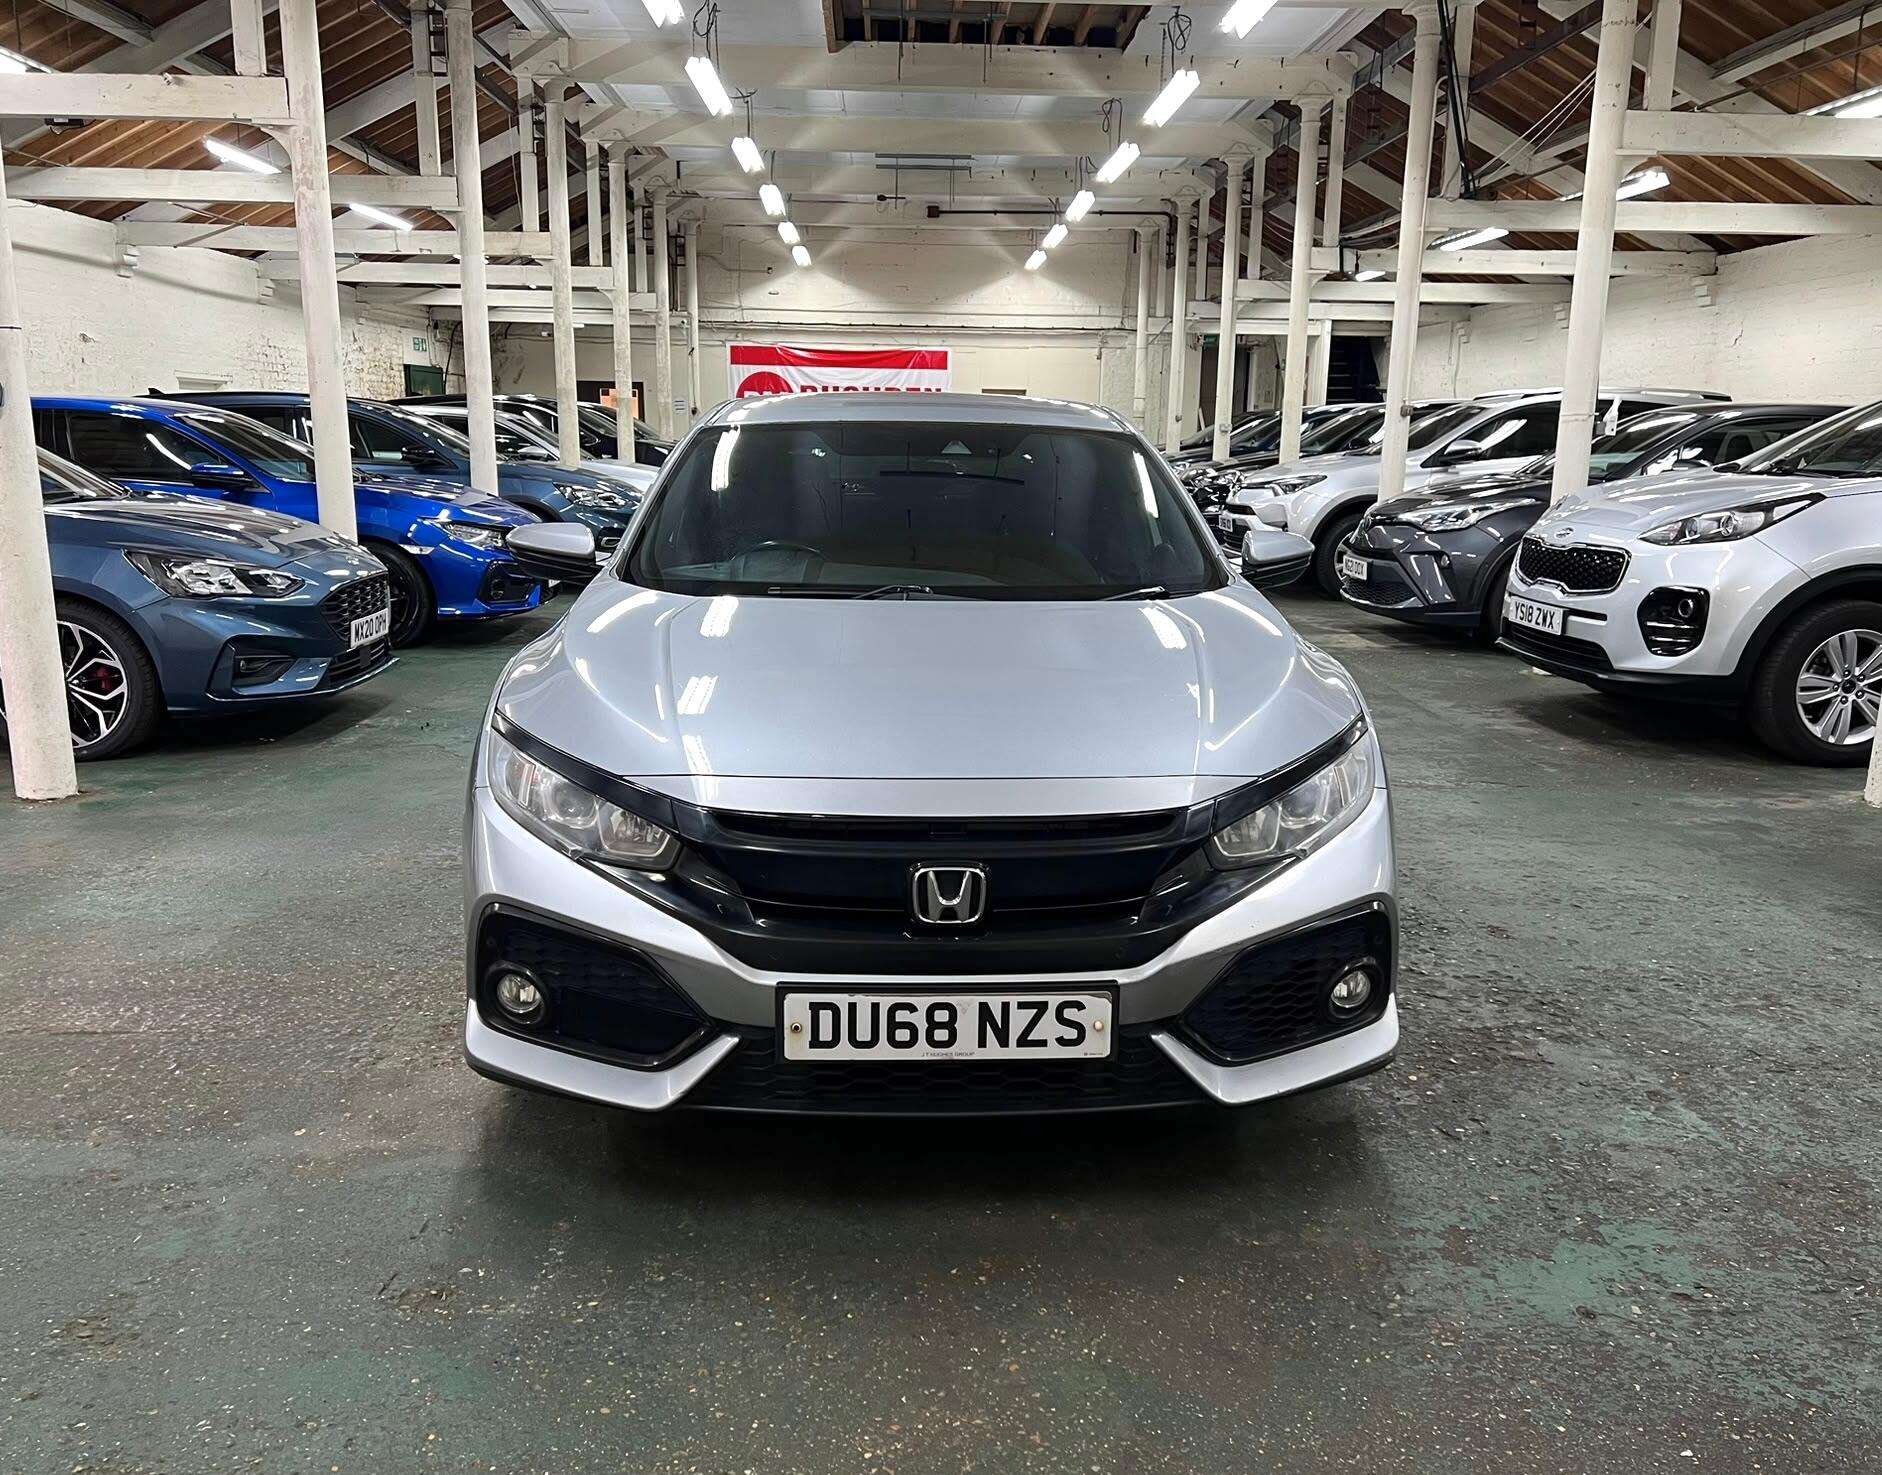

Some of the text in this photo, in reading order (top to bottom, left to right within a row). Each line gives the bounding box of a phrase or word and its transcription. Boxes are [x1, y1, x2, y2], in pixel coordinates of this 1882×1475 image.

[1515, 601, 1556, 629] YS18 ZWX
[354, 618, 373, 643] MX20
[808, 1000, 1087, 1049] DU68 NZS
